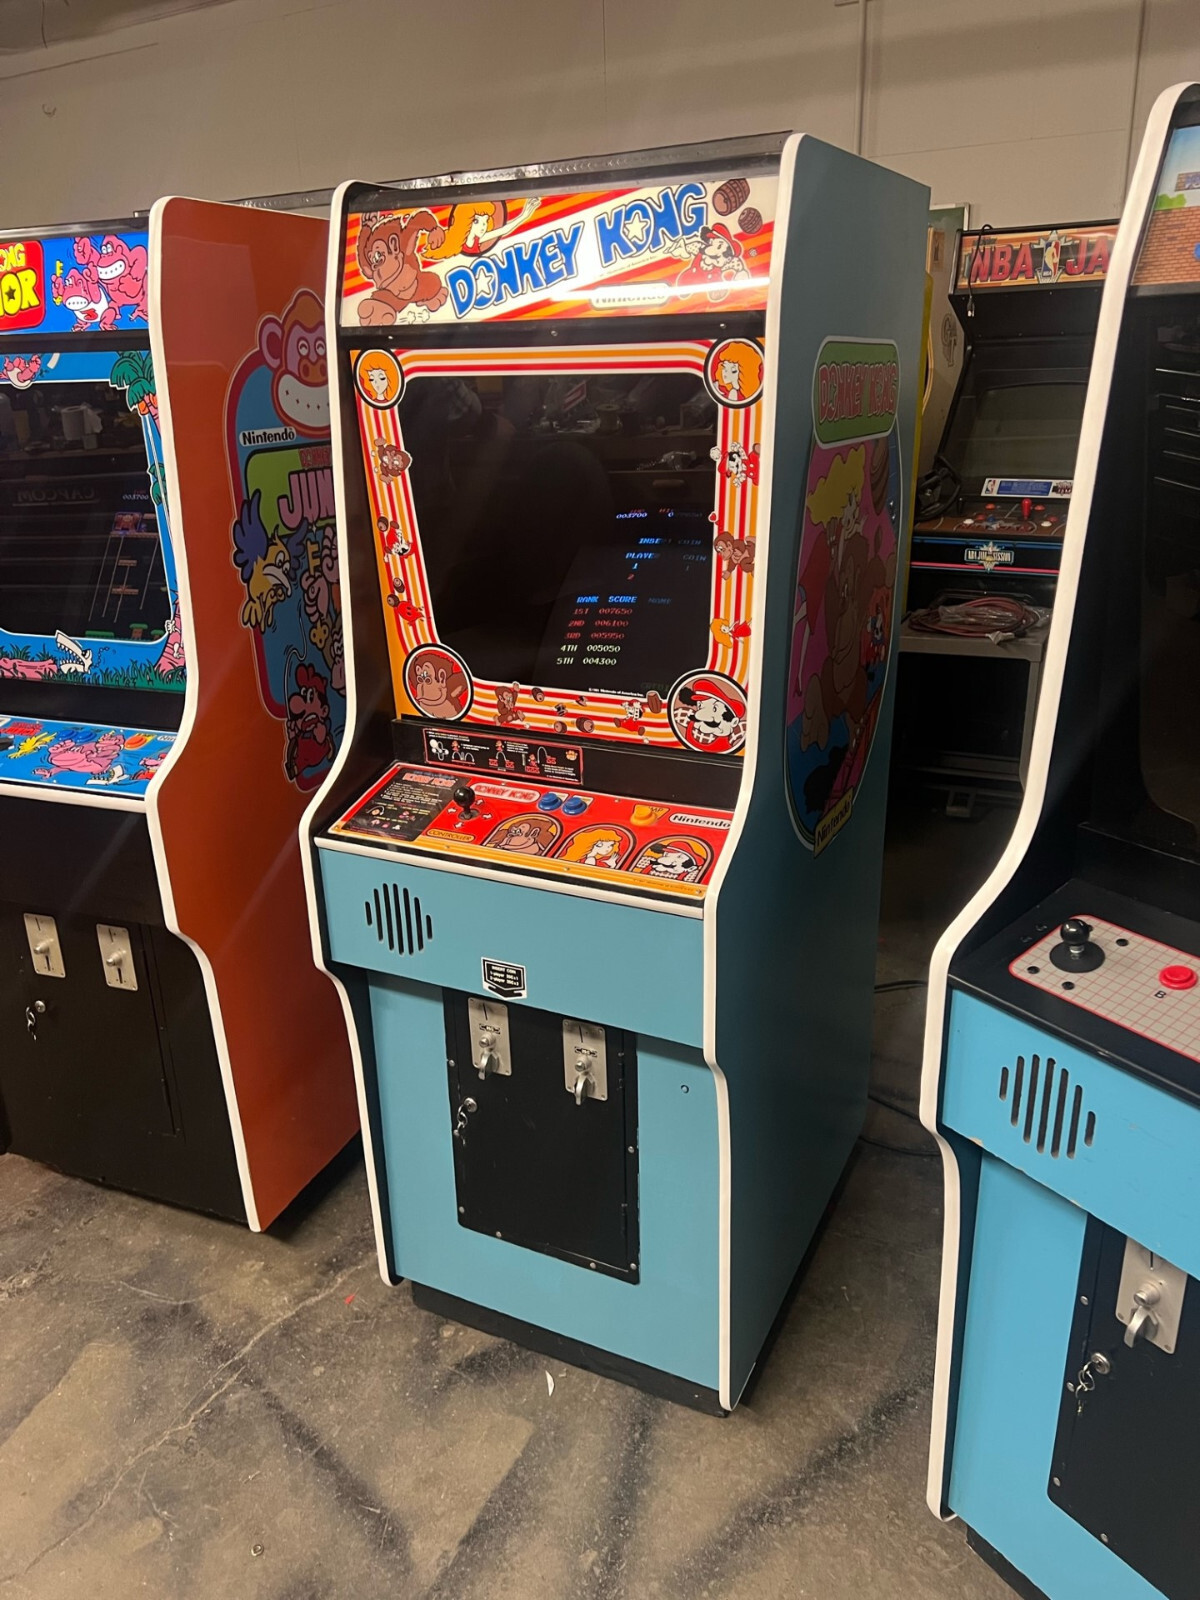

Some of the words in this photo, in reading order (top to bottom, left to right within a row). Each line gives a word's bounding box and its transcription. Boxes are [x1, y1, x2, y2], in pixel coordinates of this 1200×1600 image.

[447, 222, 585, 319] DONKEY
[597, 182, 708, 268] KONG
[970, 243, 1035, 283] NBA
[818, 361, 869, 424] DONKEY
[243, 428, 295, 445] Nintendo
[560, 644, 578, 652] 4TH
[556, 657, 574, 665] 5TH
[582, 657, 617, 665] 004300
[672, 814, 732, 828] Nintendo
[817, 800, 850, 840] Nintendo
[429, 829, 472, 841] CONTROLLER
[1154, 991, 1166, 999] B
